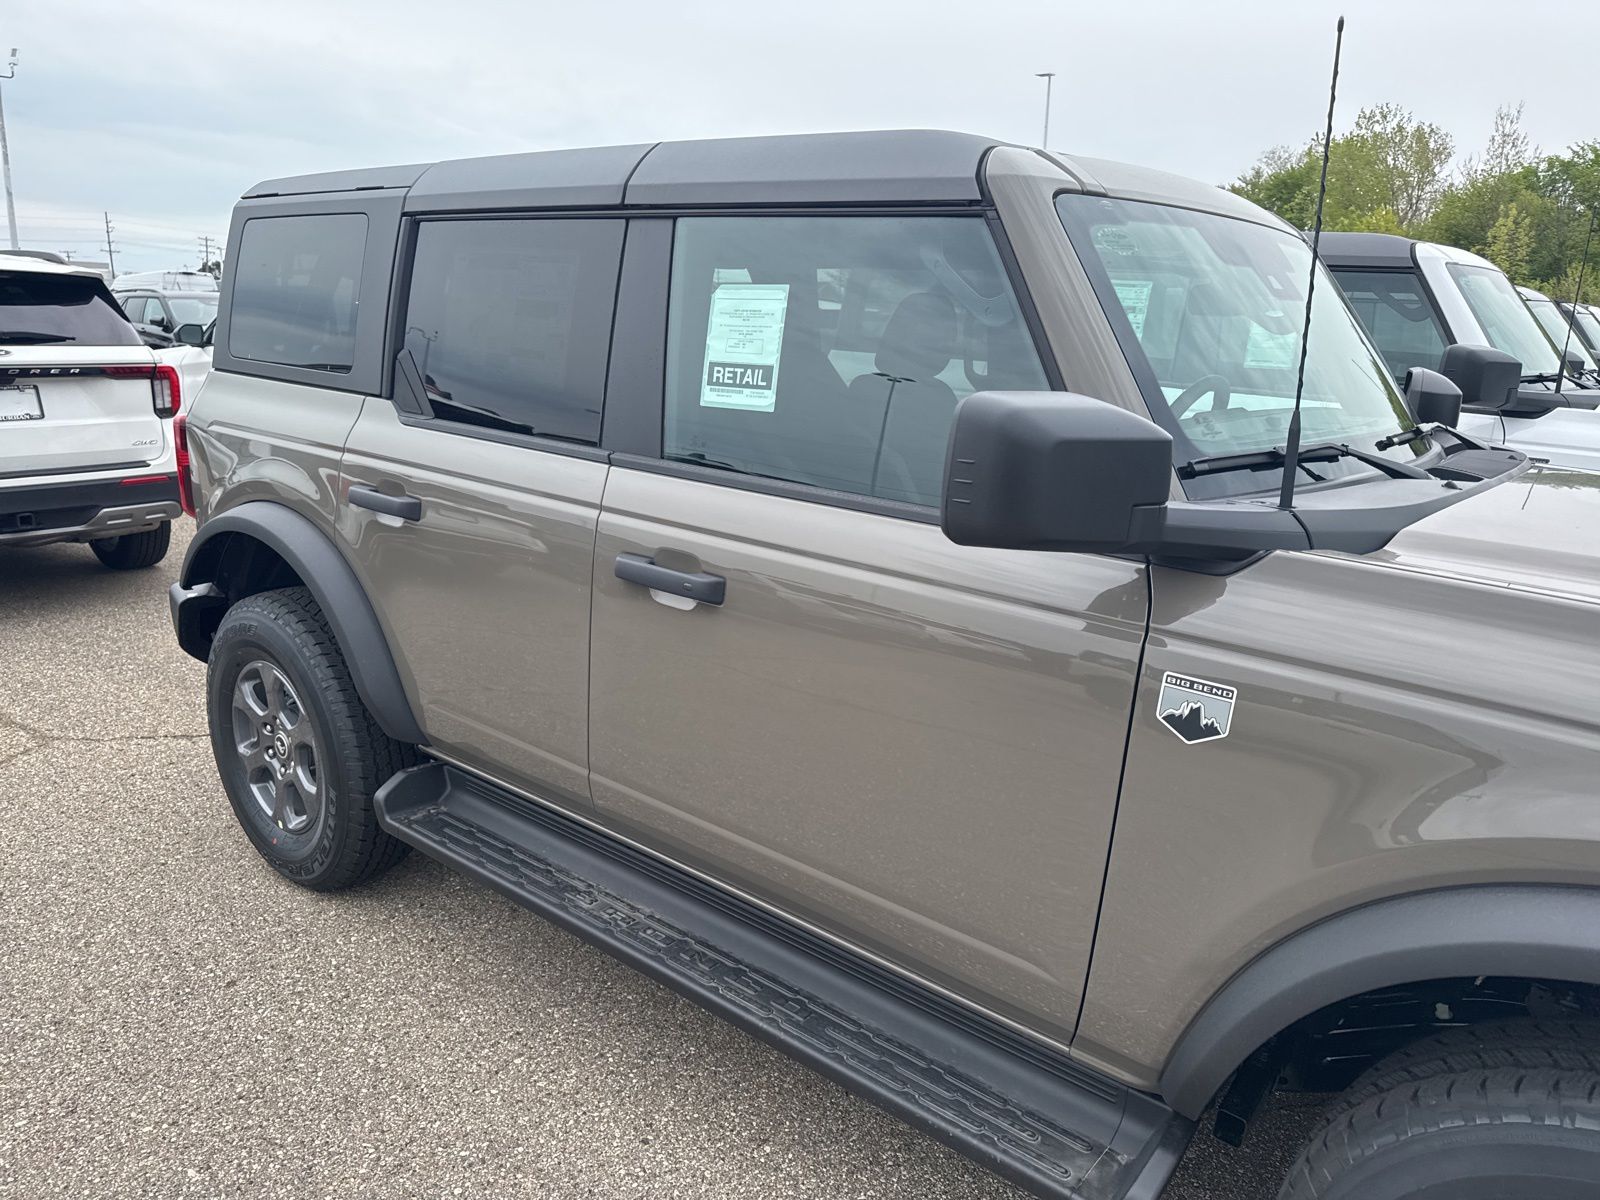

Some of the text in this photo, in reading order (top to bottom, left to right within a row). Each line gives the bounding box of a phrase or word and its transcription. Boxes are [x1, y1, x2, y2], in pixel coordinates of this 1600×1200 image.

[713, 366, 767, 386] RETAIL
[1166, 676, 1233, 698] BIG BEND
